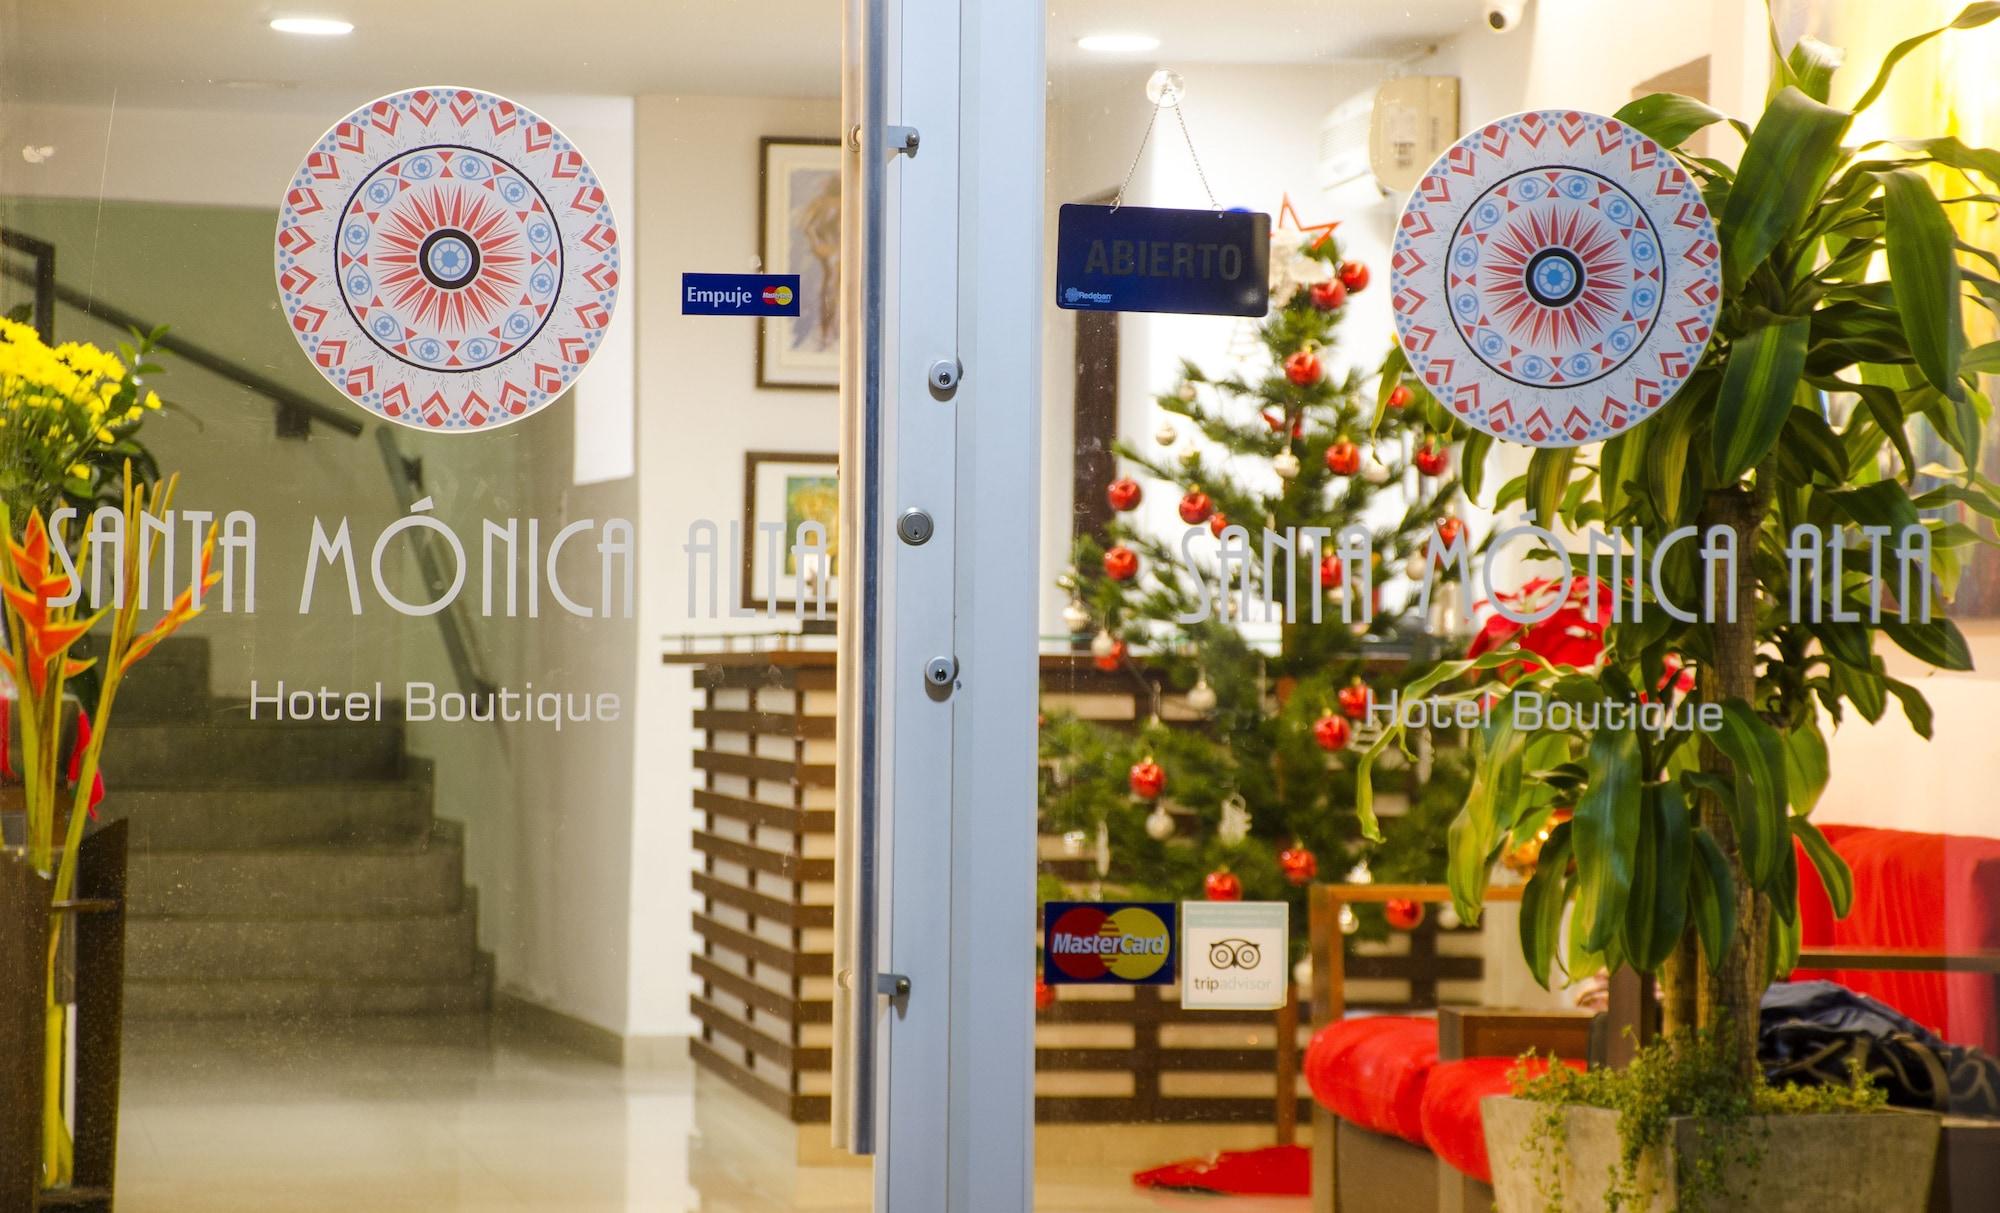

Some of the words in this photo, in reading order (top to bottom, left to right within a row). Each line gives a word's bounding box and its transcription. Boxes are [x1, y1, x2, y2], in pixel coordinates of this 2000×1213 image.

[1085, 240, 1242, 280] ABIERTO
[687, 286, 753, 308] Empuje
[47, 506, 257, 614] SANTA
[299, 495, 635, 619] MÓNICA
[682, 519, 827, 620] ALTA
[1179, 524, 1374, 624] SANTA
[1419, 508, 1738, 625] MÓNICA
[1785, 523, 1932, 625] ALTA
[250, 680, 383, 722] Hotel
[406, 681, 622, 732] Boutique
[1366, 688, 1492, 729] Hotel
[1513, 690, 1724, 741] Boutique
[1053, 933, 1167, 955] MasterCard
[1194, 976, 1272, 993] tripadvisor
